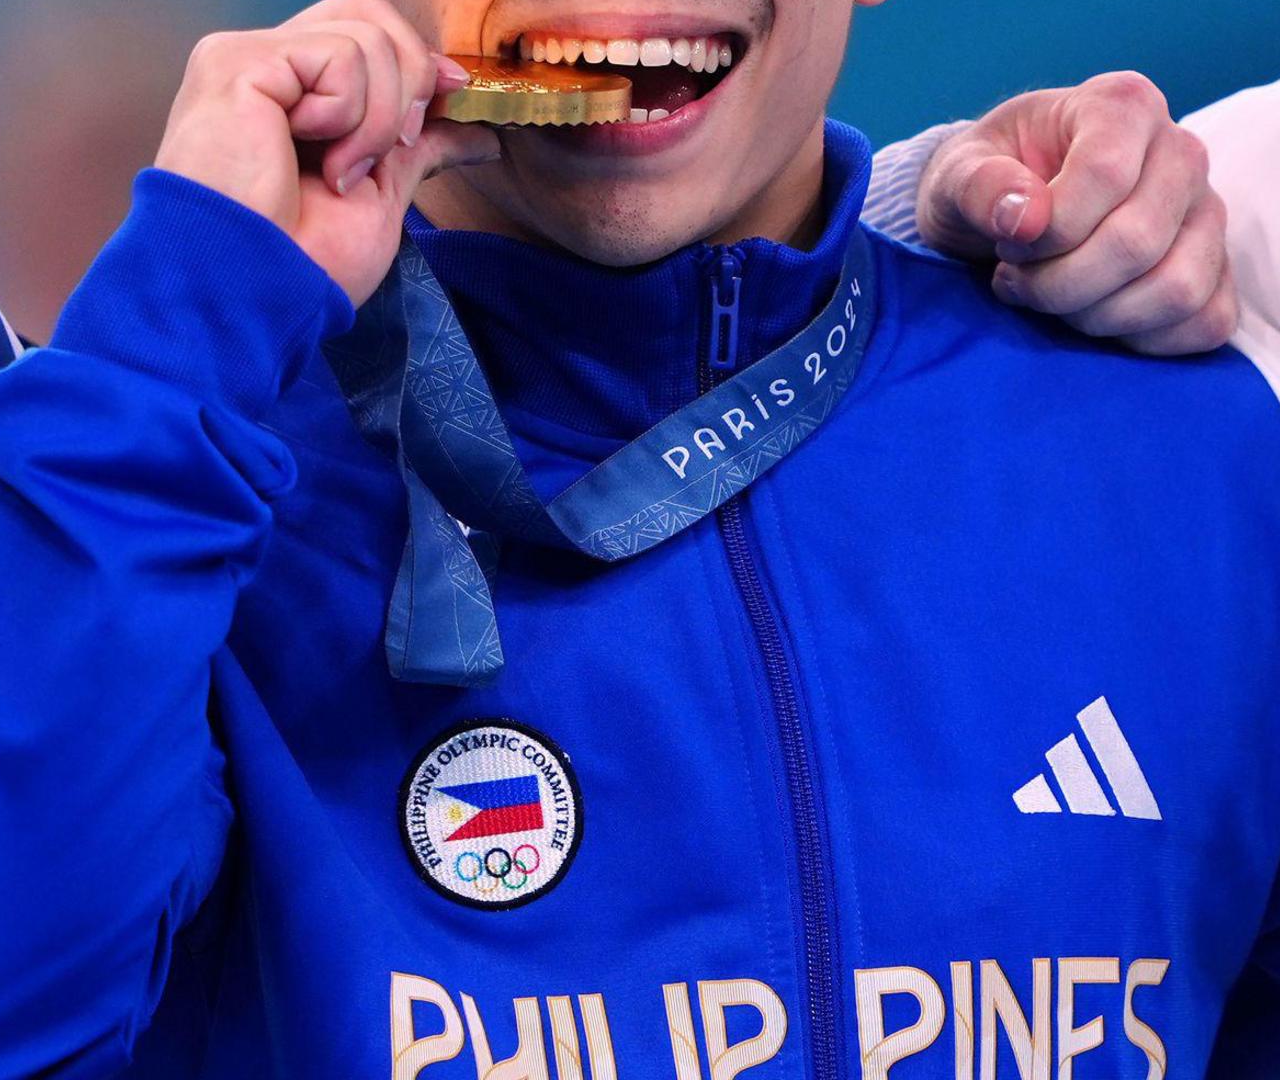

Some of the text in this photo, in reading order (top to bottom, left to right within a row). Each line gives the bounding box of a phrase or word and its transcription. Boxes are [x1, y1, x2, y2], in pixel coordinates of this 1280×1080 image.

[803, 277, 862, 385] 2024
[407, 732, 571, 869] PHILIPPINE OLYMPIC COMMITTEE
